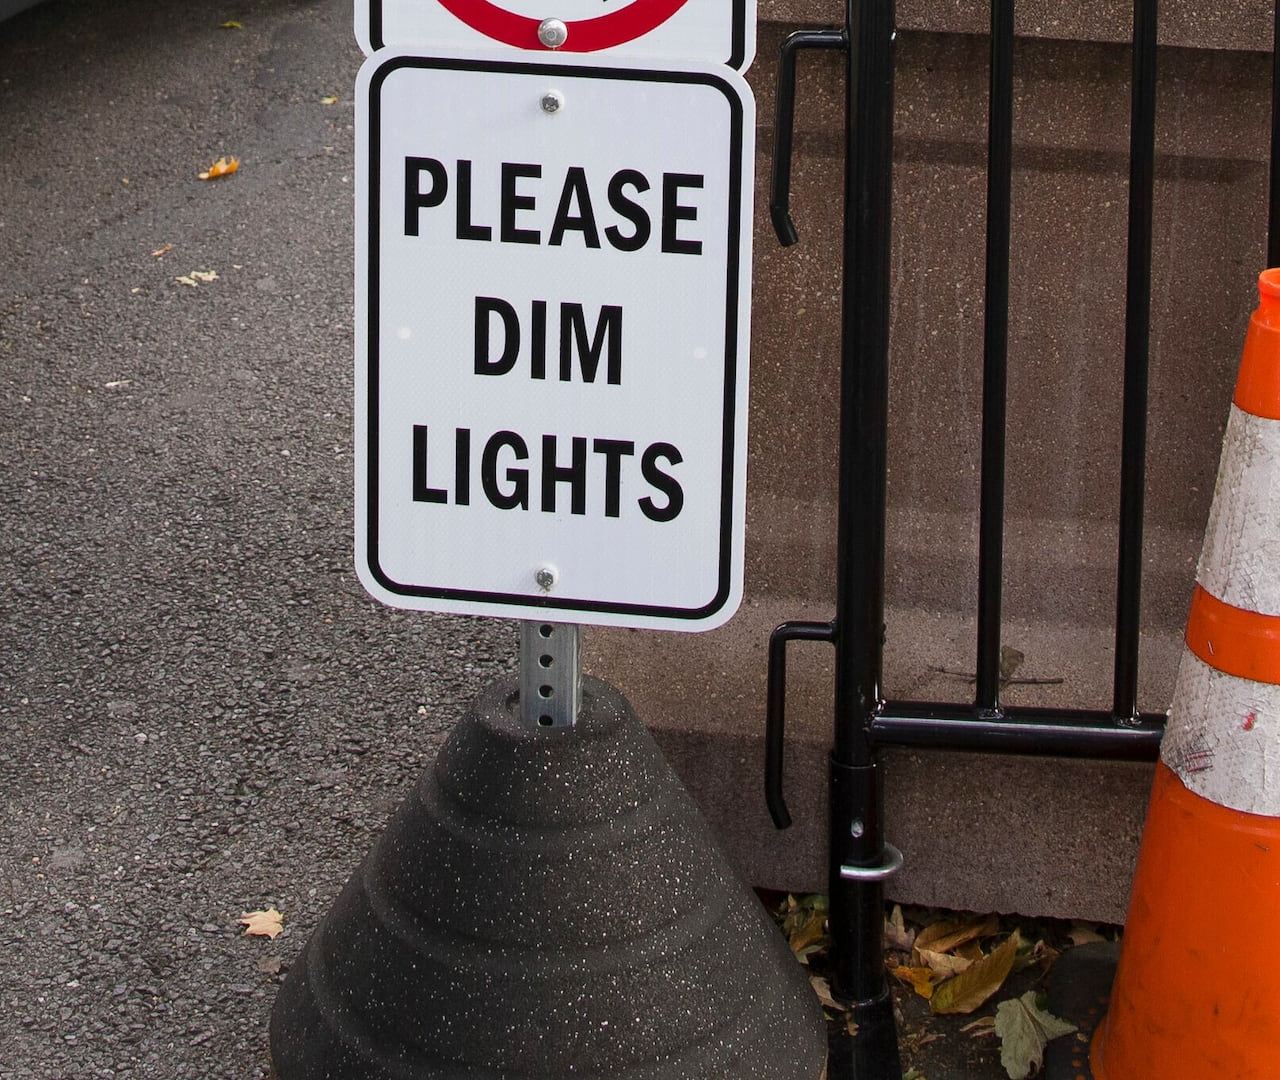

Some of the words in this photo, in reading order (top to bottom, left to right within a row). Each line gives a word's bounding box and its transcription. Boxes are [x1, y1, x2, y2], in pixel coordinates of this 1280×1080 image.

[404, 155, 705, 256] PLEASE
[473, 295, 623, 386] DIM
[412, 424, 684, 523] LIGHTS
